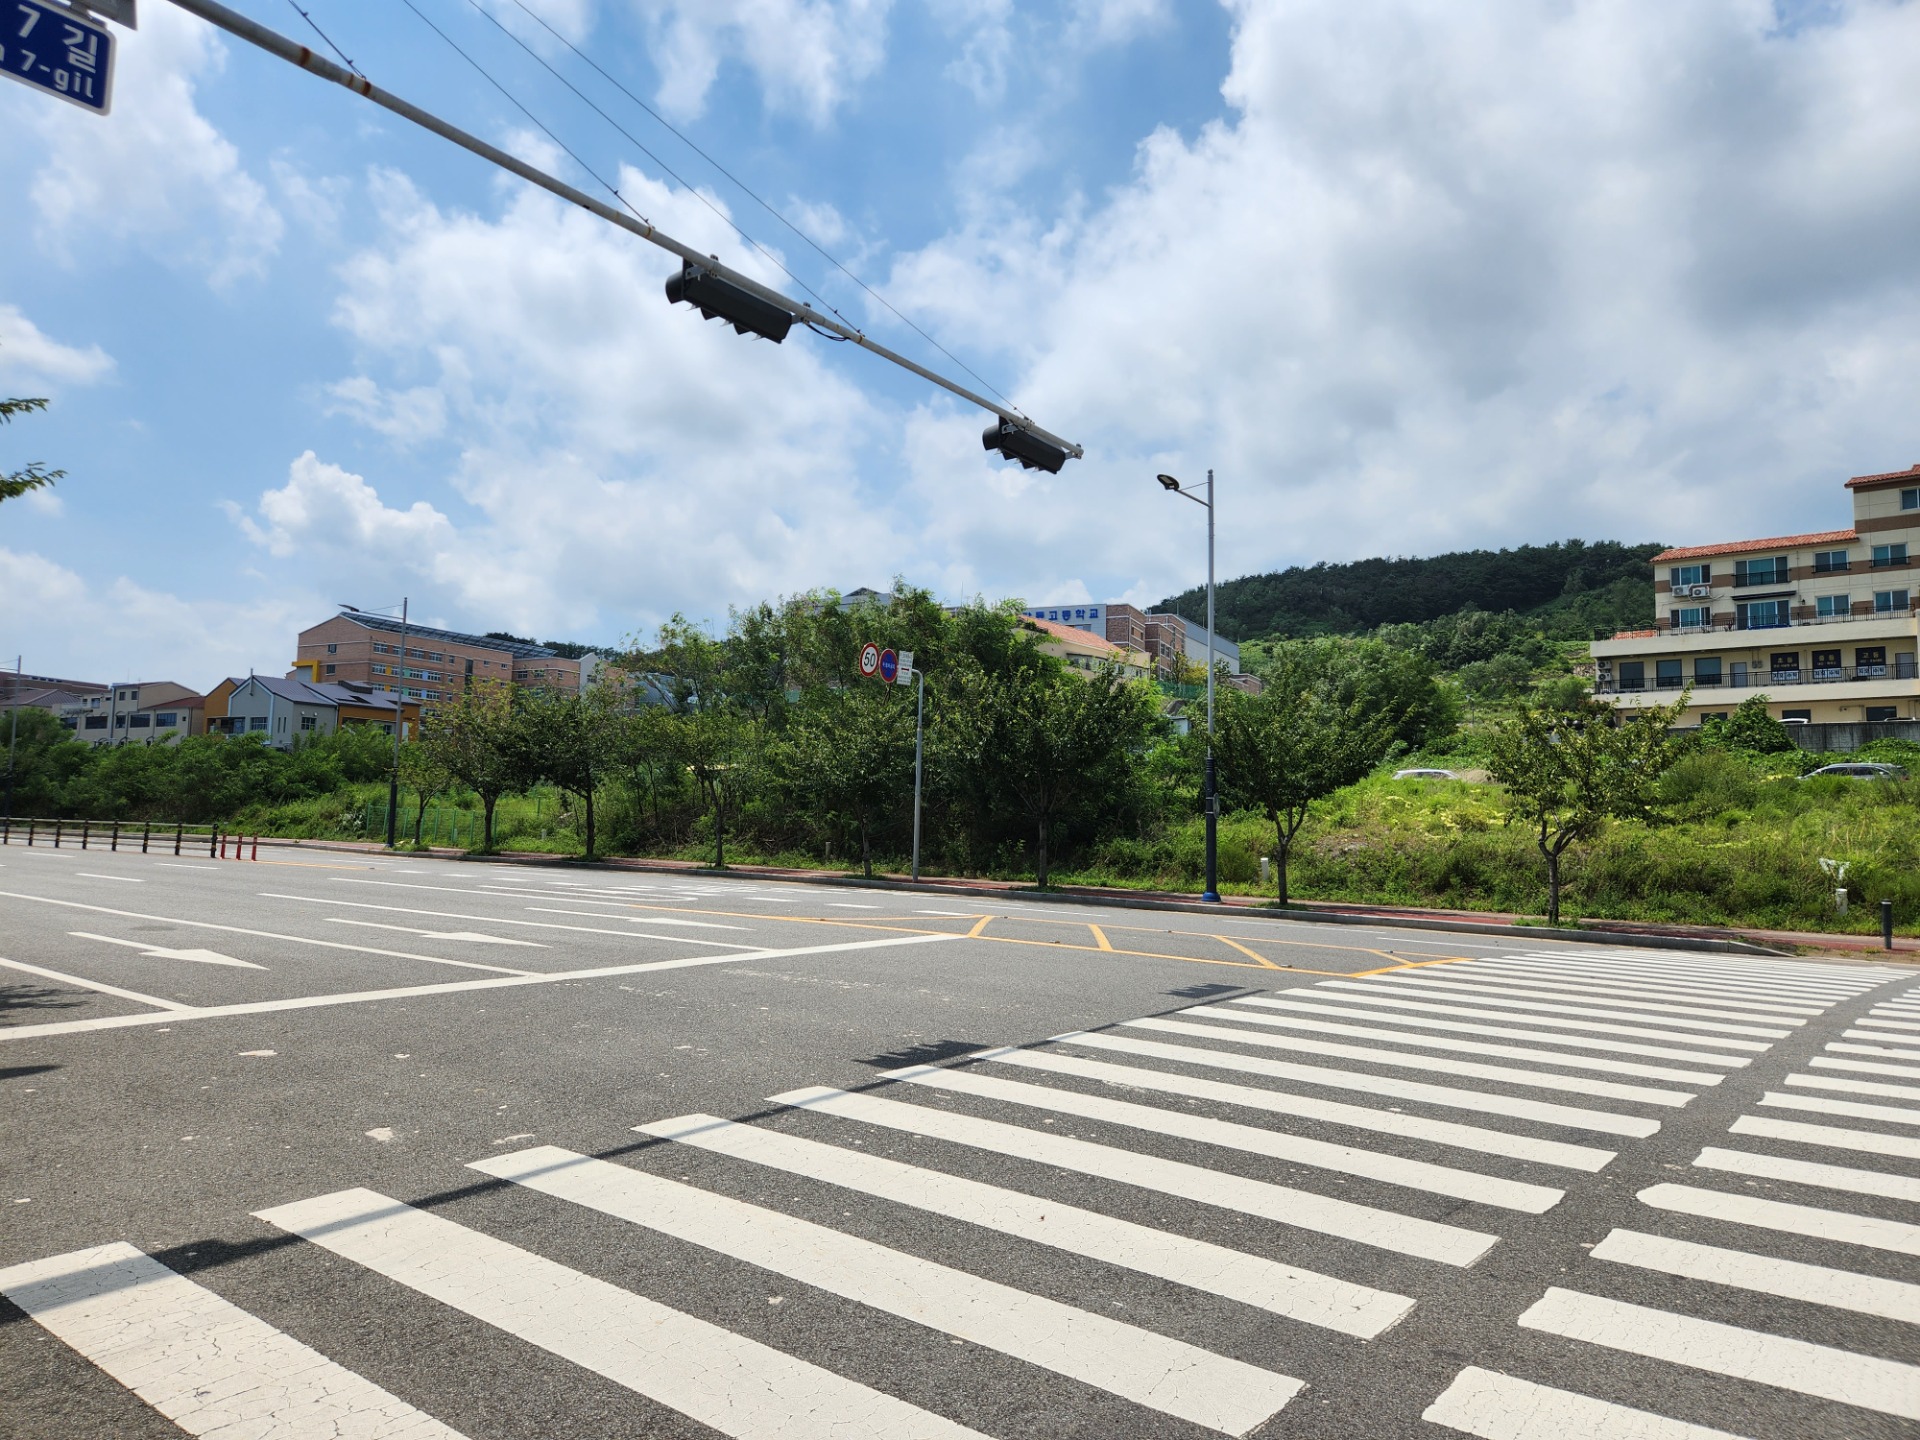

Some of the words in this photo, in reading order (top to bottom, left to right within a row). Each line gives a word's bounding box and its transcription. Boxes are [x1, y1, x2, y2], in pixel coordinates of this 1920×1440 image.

[18, 4, 40, 38] 7
[62, 24, 98, 74] 길
[21, 49, 93, 99] 7-gil
[863, 652, 876, 667] 50
